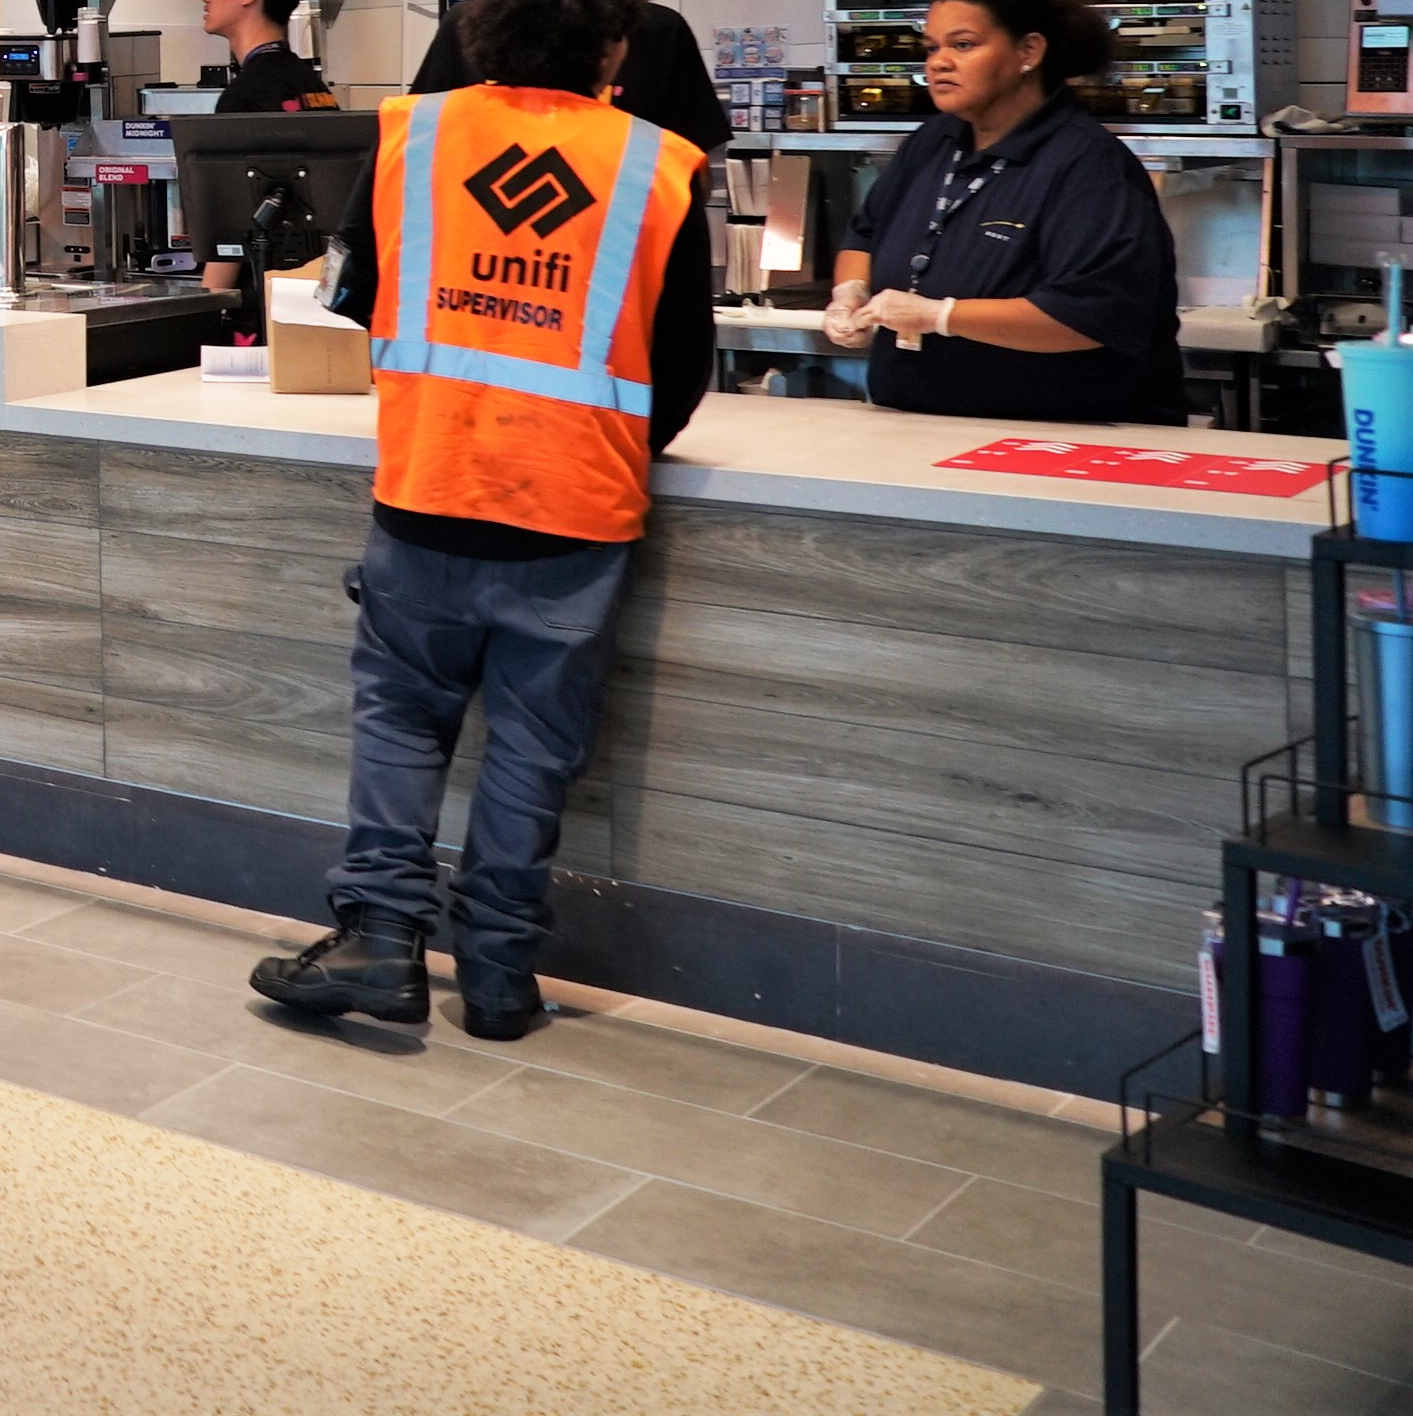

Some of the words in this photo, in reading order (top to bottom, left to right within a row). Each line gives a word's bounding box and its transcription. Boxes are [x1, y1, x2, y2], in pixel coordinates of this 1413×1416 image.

[125, 129, 165, 137] MIDNIGHT
[98, 166, 135, 174] ORIGINAL
[98, 174, 123, 182] BLEND
[471, 248, 571, 293] unifi
[437, 286, 563, 331] SUPERVISOR
